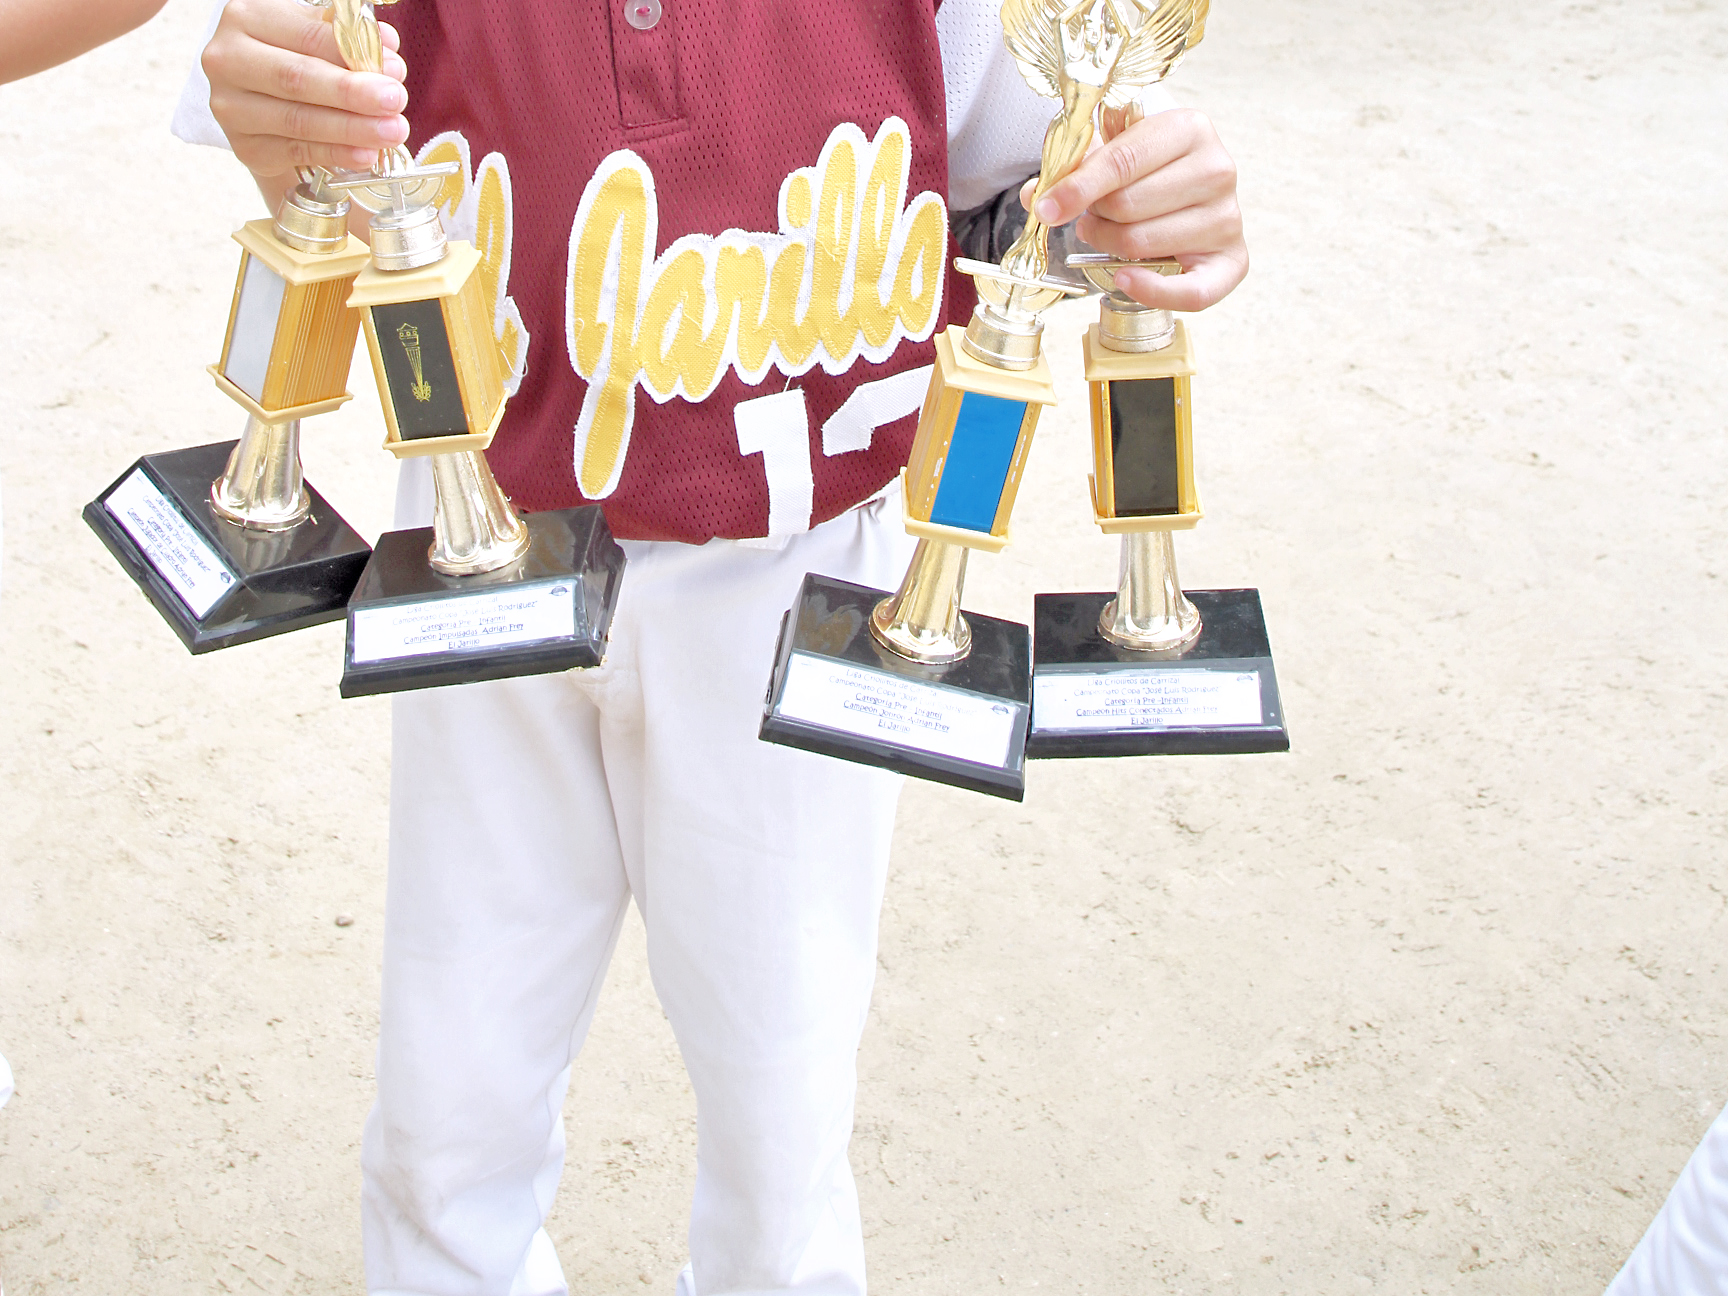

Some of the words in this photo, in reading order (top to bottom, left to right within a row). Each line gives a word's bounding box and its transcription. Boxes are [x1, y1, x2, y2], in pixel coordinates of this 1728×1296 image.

[566, 116, 950, 500] Jarillo
[392, 613, 436, 625] Campeonato
[438, 610, 457, 619] Copa
[458, 619, 471, 627] Pre
[478, 615, 505, 625] Infantil
[438, 628, 477, 640] Impulsadas
[481, 625, 507, 634] Adrian
[447, 641, 455, 649] El
[846, 668, 862, 678] Liga
[828, 675, 875, 692] Campeonato
[876, 686, 896, 698] Copa
[893, 701, 907, 711] Pre
[914, 706, 942, 720] Infantil
[877, 718, 886, 727] El
[1140, 716, 1163, 724] Jarillo
